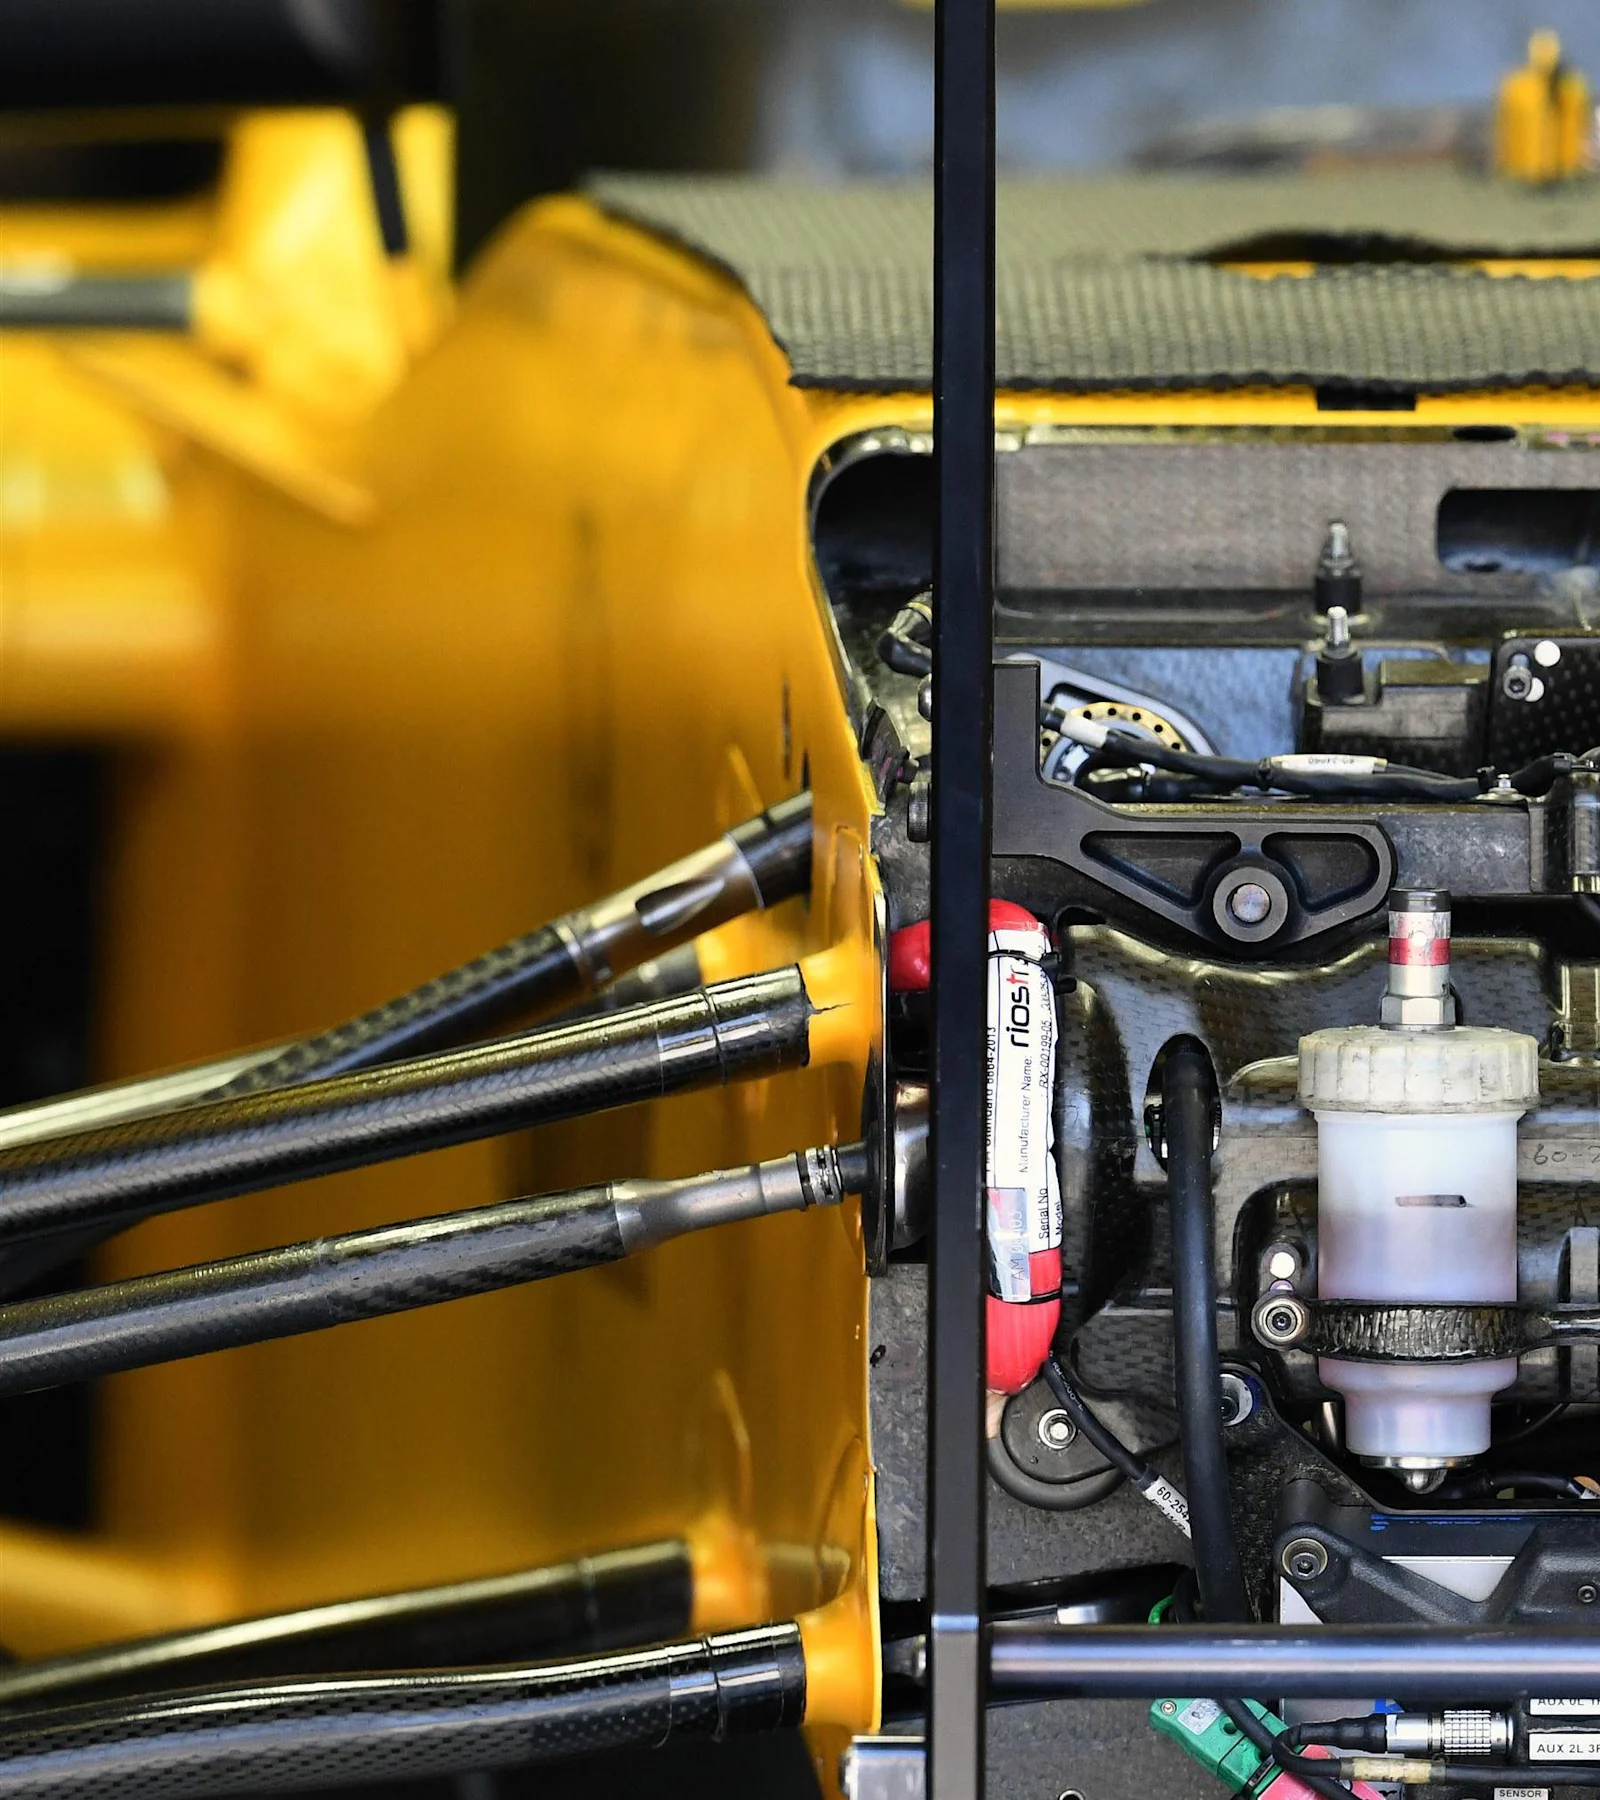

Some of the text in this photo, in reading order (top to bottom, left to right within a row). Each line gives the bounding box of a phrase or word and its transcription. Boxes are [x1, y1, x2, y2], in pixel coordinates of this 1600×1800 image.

[1005, 958, 1033, 1173] Manufacturer Name: riostr
[1037, 1188, 1048, 1204] No
[1038, 1208, 1049, 1239] Serial
[1537, 1744, 1565, 1753] AUX
[1569, 1744, 1584, 1753] 2L
[1499, 1789, 1542, 1798] SENSOR
